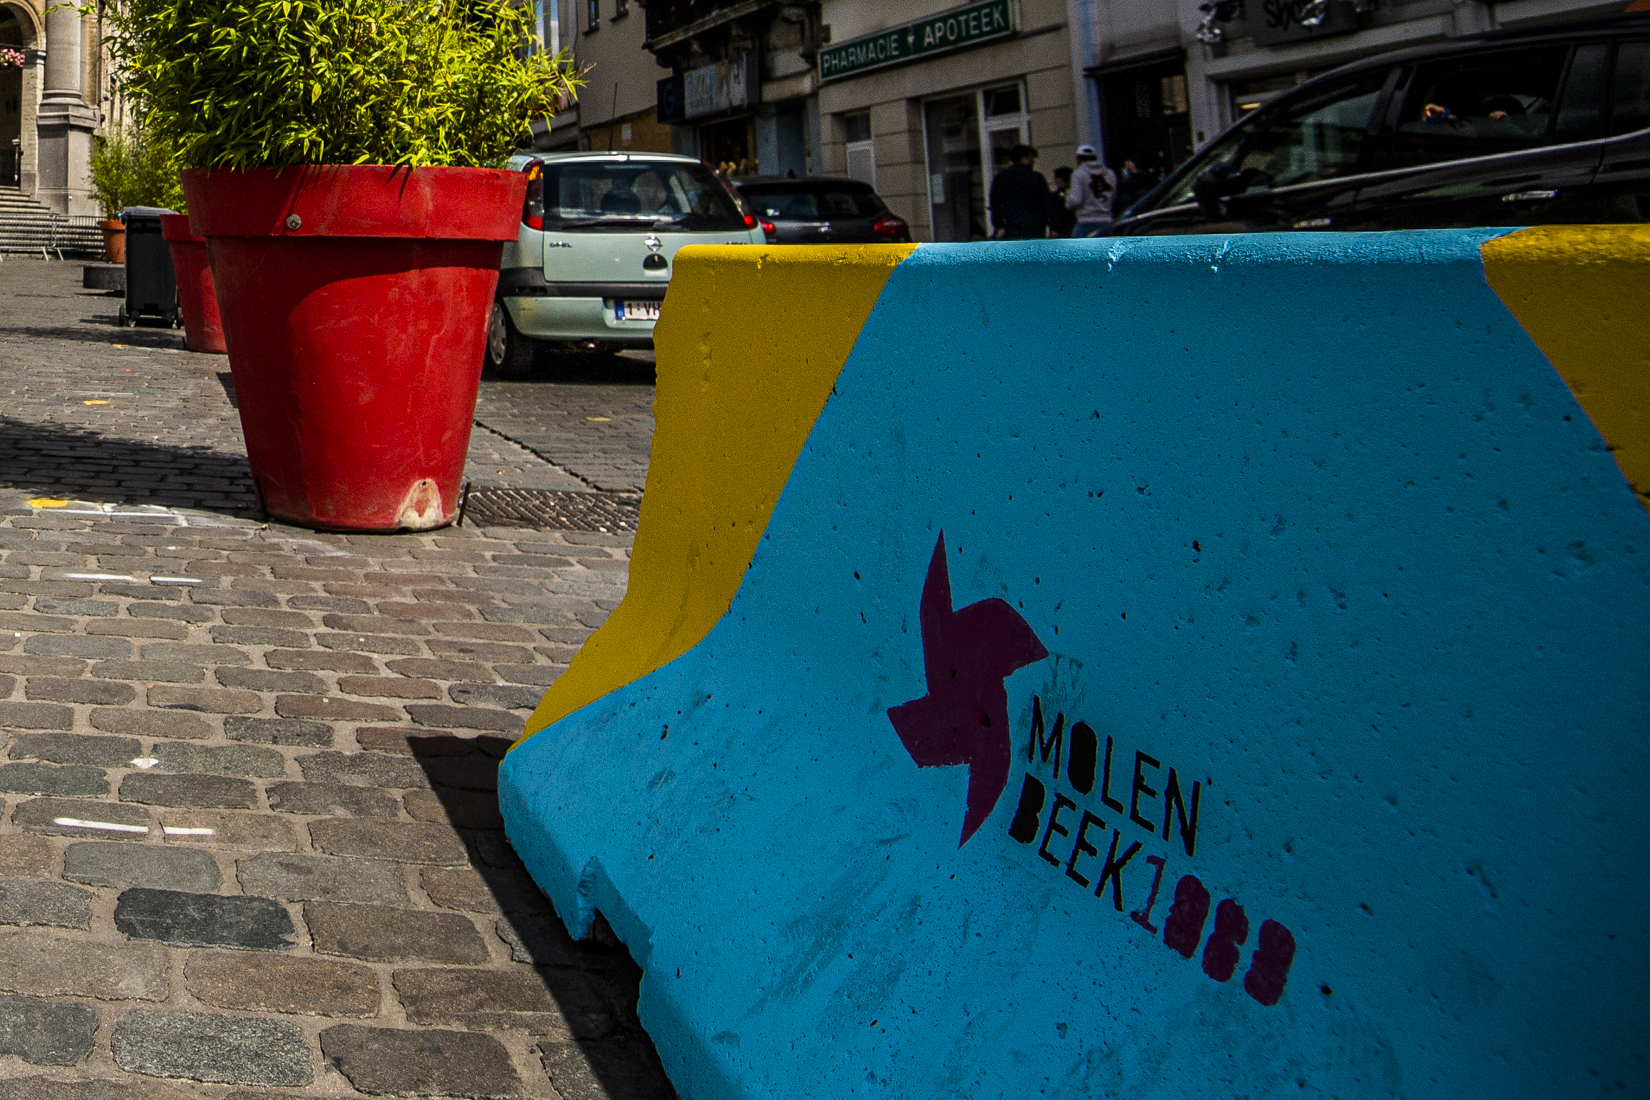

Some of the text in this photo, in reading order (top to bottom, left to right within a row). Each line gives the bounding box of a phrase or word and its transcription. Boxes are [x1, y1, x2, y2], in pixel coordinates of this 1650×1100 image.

[822, 3, 1006, 75] PHARMACIE APOTEEK
[1028, 695, 1202, 857] MOLEN
